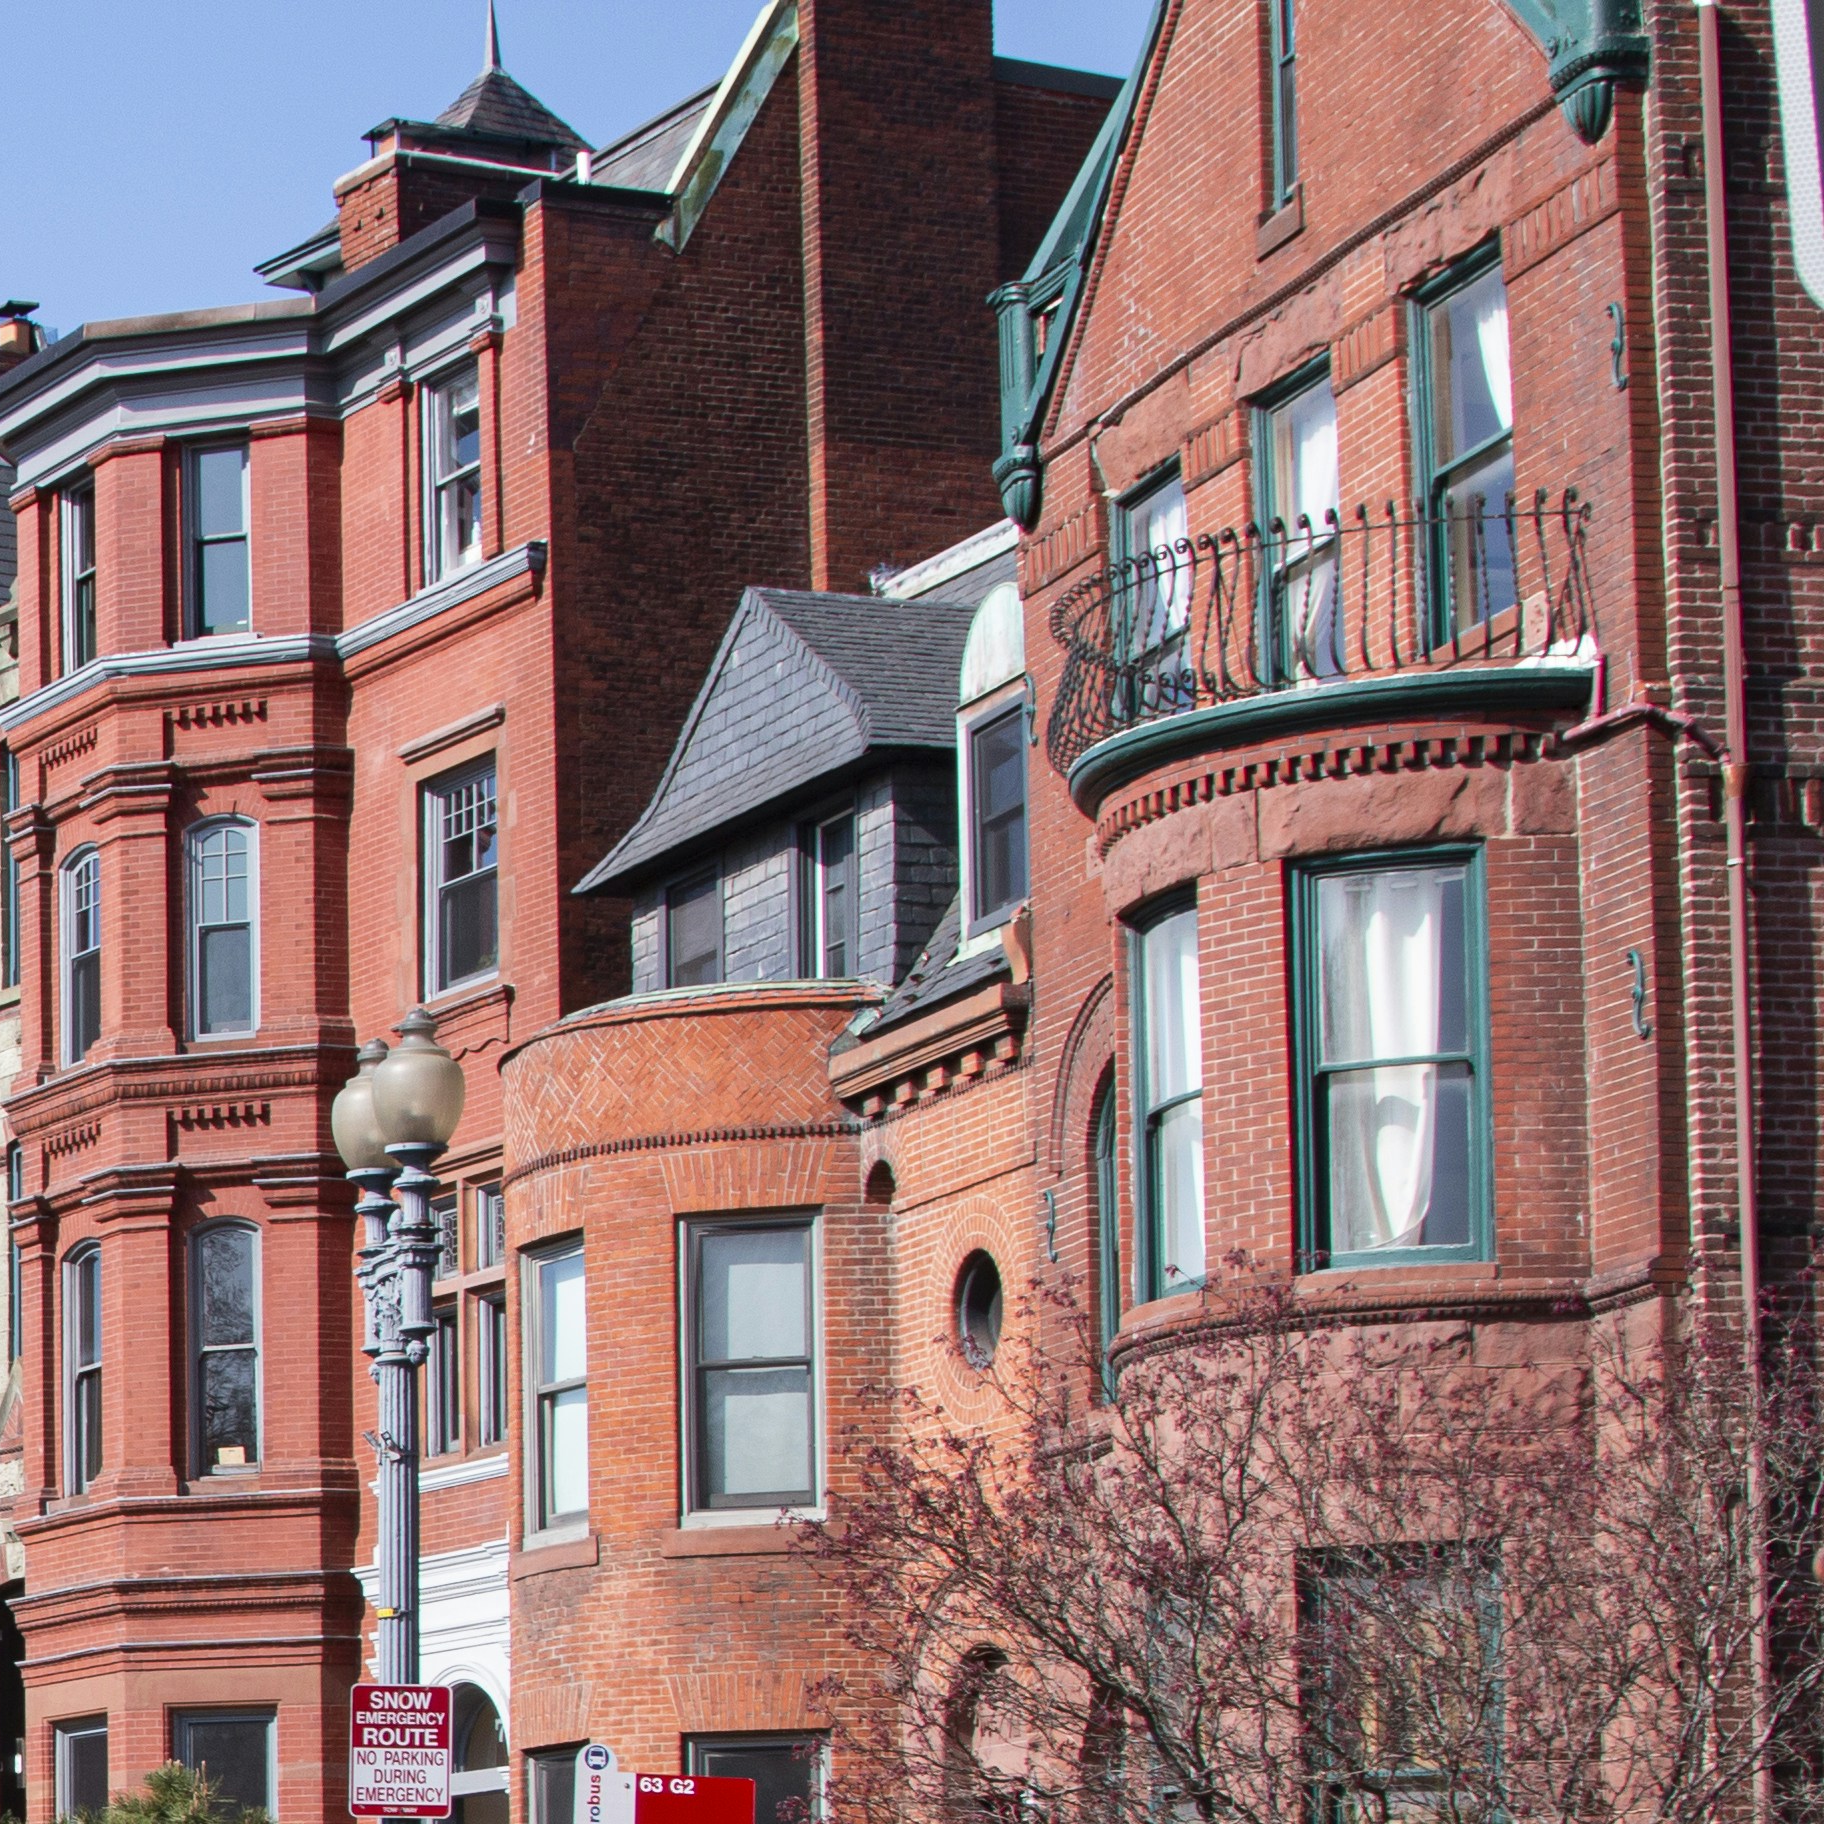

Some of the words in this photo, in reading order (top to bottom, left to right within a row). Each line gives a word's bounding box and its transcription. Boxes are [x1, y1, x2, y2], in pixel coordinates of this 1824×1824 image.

[370, 1691, 432, 1710] SNOW
[356, 1712, 445, 1725] EMERGENCY
[363, 1728, 438, 1746] ROUTE
[356, 1750, 376, 1766] NO
[384, 1751, 444, 1766] PARKING
[374, 1769, 426, 1784] DURING
[640, 1777, 663, 1792] 63
[670, 1778, 694, 1794] G2
[356, 1787, 444, 1802] EMERGENCY
